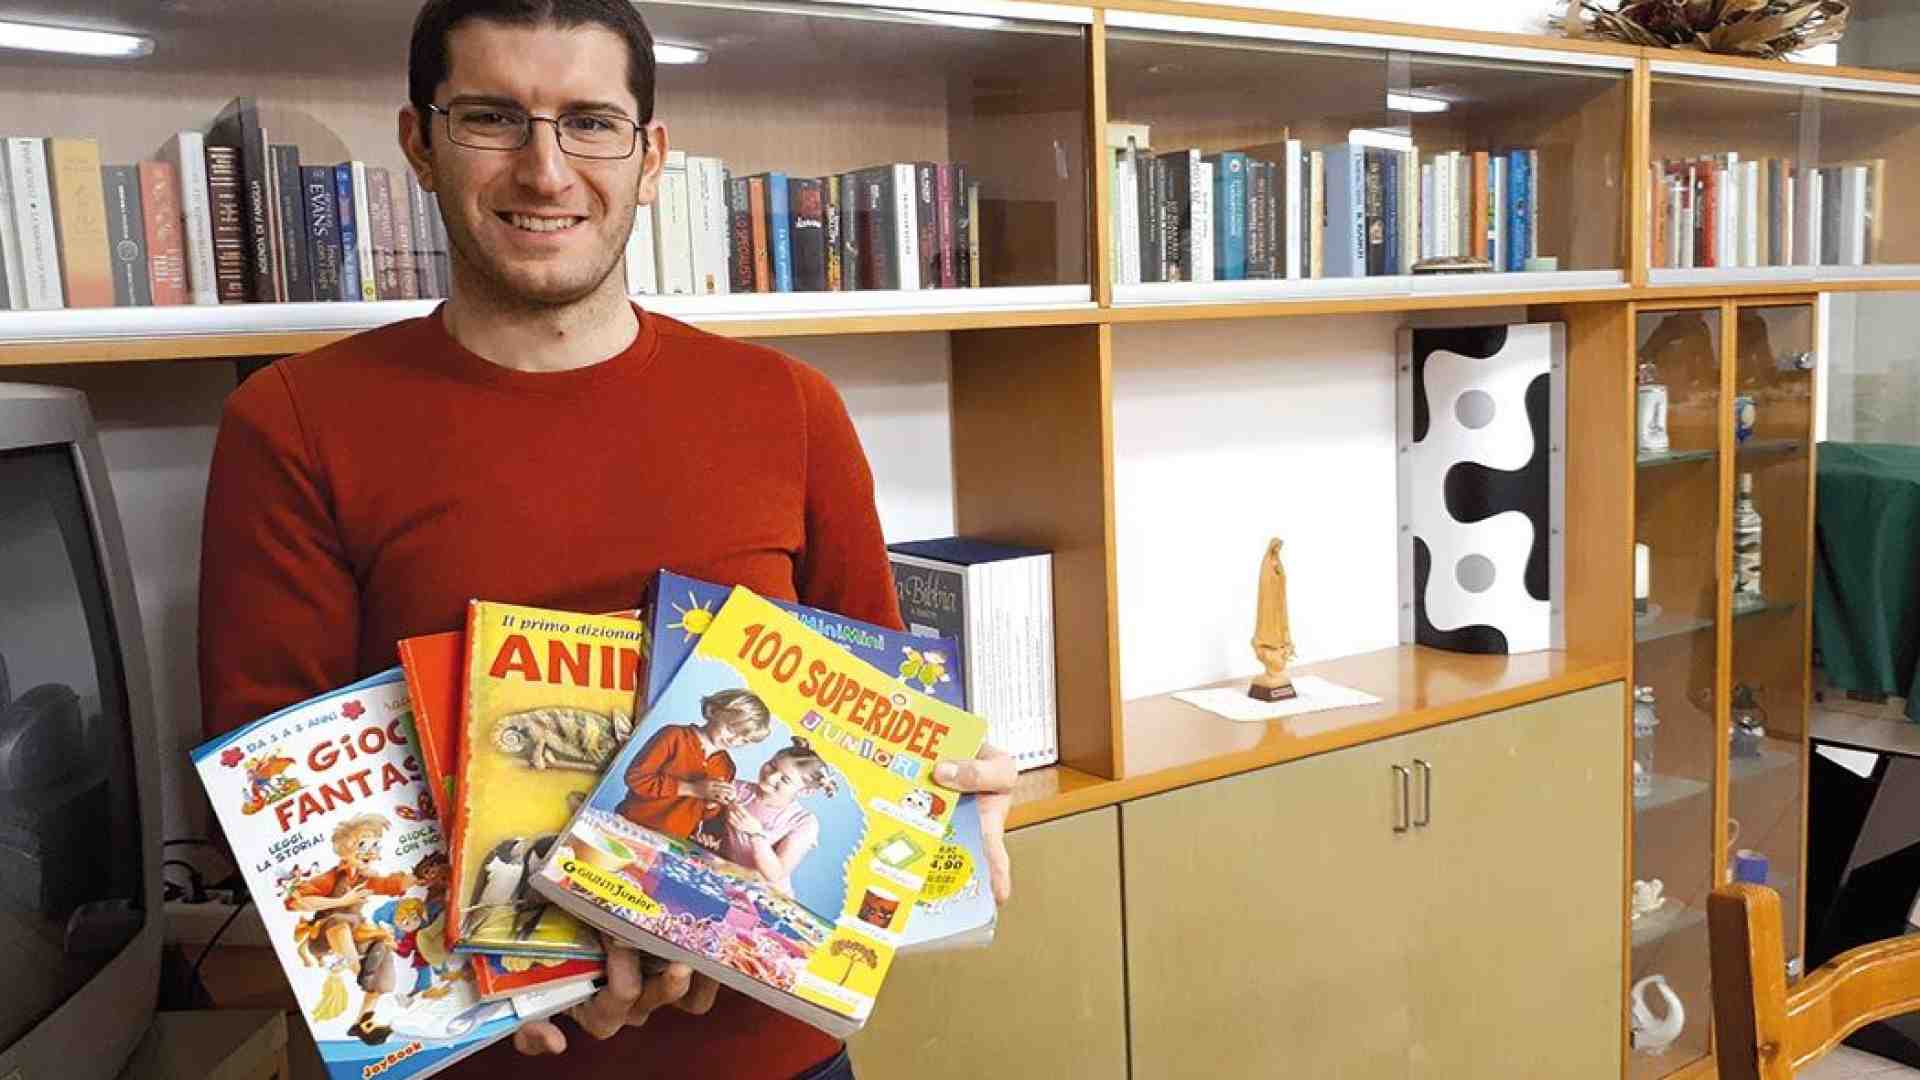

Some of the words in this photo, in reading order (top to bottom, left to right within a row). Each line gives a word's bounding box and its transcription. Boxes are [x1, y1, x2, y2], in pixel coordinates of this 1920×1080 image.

[309, 184, 328, 237] EVANS
[501, 614, 514, 627] Il
[520, 619, 570, 634] primo
[738, 623, 803, 684] 100
[799, 709, 921, 781] JUNIOR
[256, 860, 272, 873] LA
[275, 832, 325, 863] STORIA!
[267, 832, 303, 855] LEGGI
[930, 859, 963, 872] 4,90
